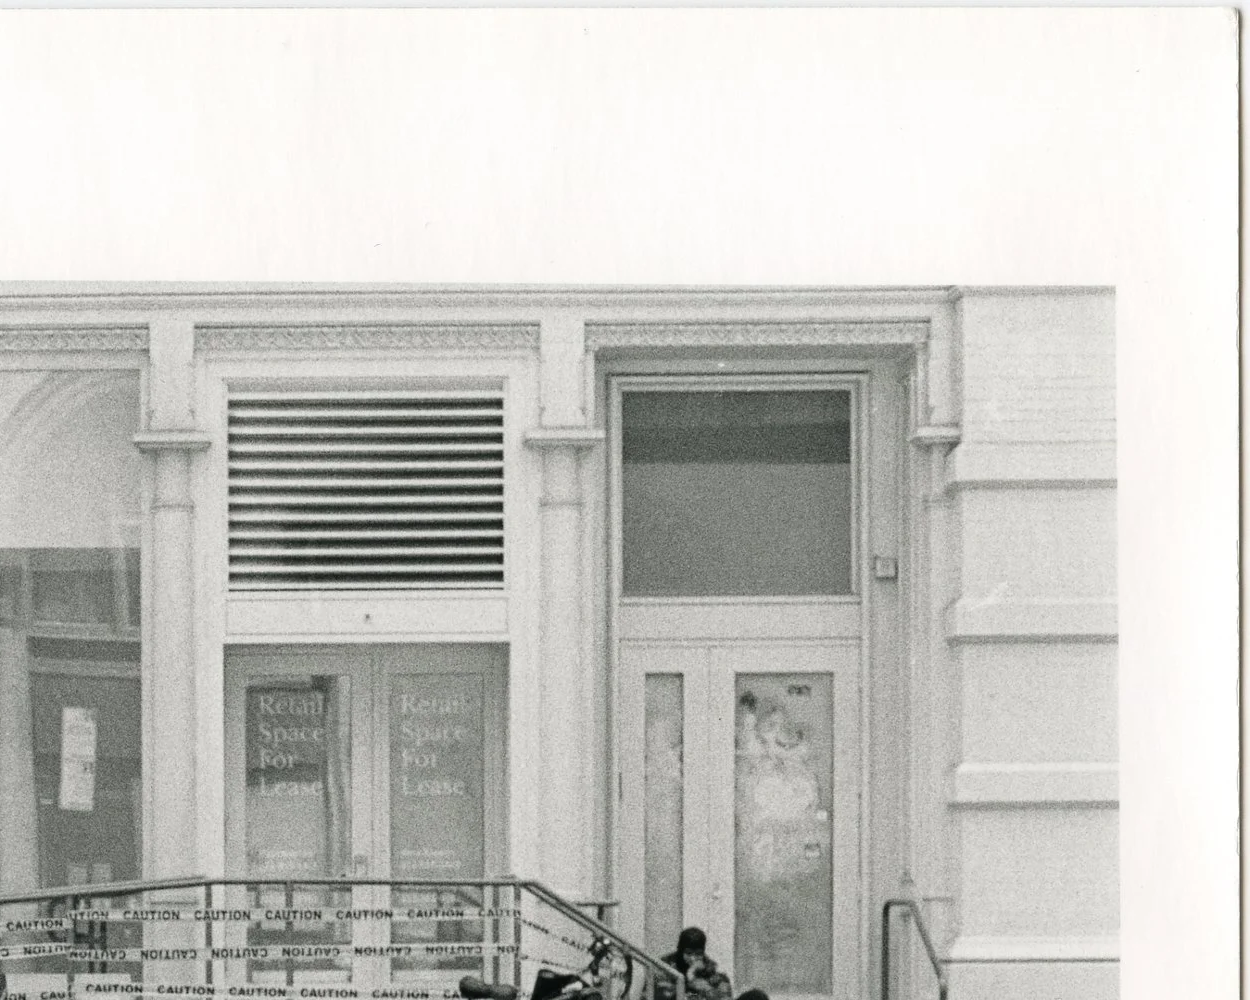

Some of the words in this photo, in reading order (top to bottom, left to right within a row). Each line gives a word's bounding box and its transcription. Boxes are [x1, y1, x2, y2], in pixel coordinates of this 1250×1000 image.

[259, 694, 323, 715] Retail
[259, 724, 324, 745] Space
[260, 750, 296, 768] For
[402, 750, 438, 768] For
[260, 777, 323, 796] Lease
[402, 776, 466, 796] Lease
[123, 910, 180, 921] CAUTION
[194, 910, 250, 921] CAUTION
[265, 910, 322, 921] CAUTION
[336, 910, 393, 920] CAUTION
[6, 919, 63, 931] CAUTION
[70, 950, 126, 960] CAUTION
[141, 950, 197, 960] CAUTION
[211, 948, 268, 959] CAUTION
[282, 947, 340, 958] CAUTION
[86, 984, 143, 994] CAUTION
[157, 985, 215, 996] CAUTION
[229, 986, 286, 997] CAUTION
[300, 988, 358, 998] CAUTION
[372, 988, 429, 999] CAUTION
